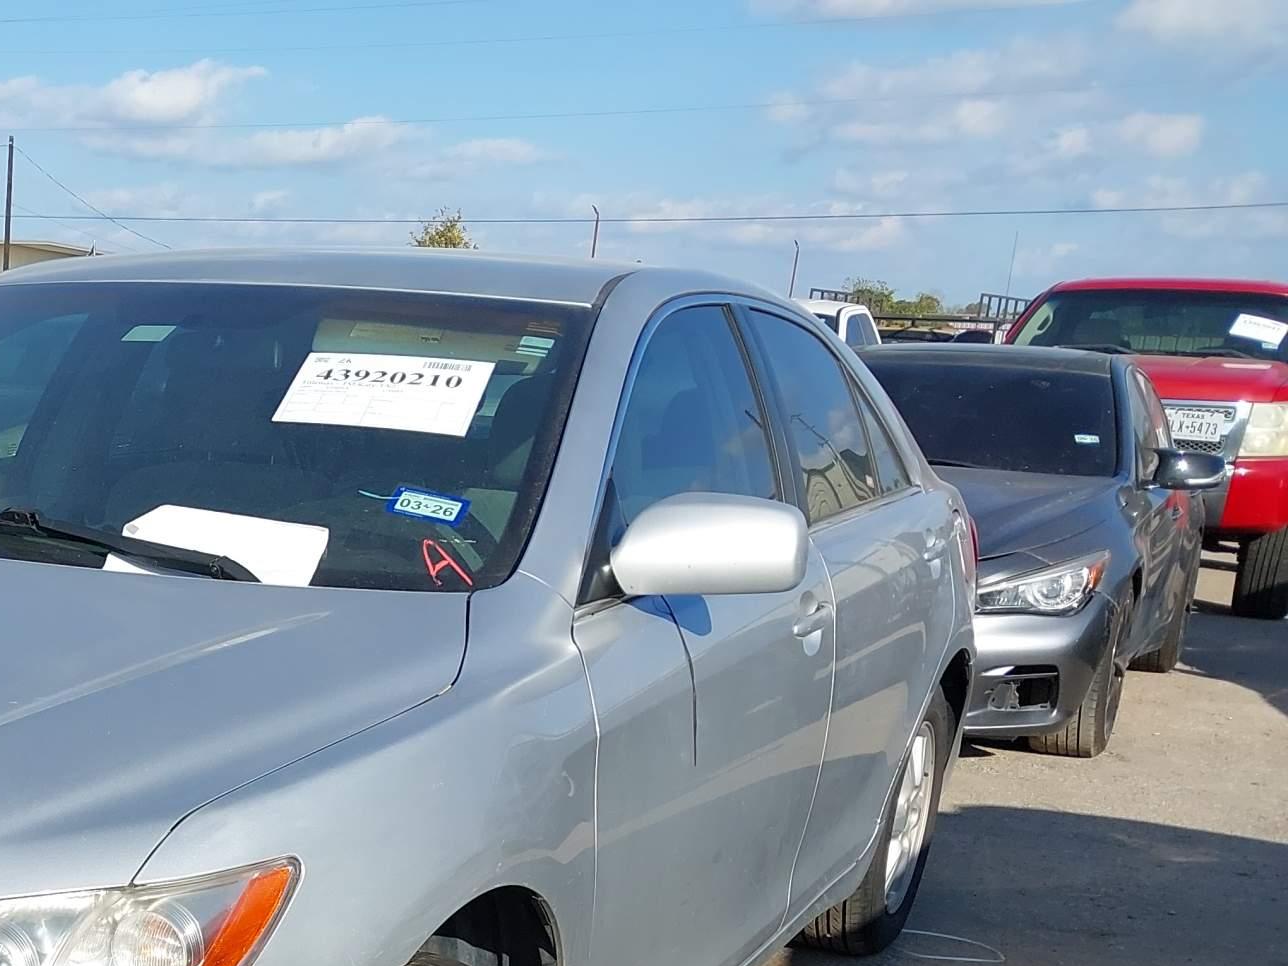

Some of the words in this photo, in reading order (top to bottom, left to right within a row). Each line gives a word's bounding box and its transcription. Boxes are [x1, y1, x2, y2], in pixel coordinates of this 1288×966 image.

[316, 368, 463, 389] 43920210
[1182, 412, 1206, 420] TEXAS
[423, 539, 473, 586] A
